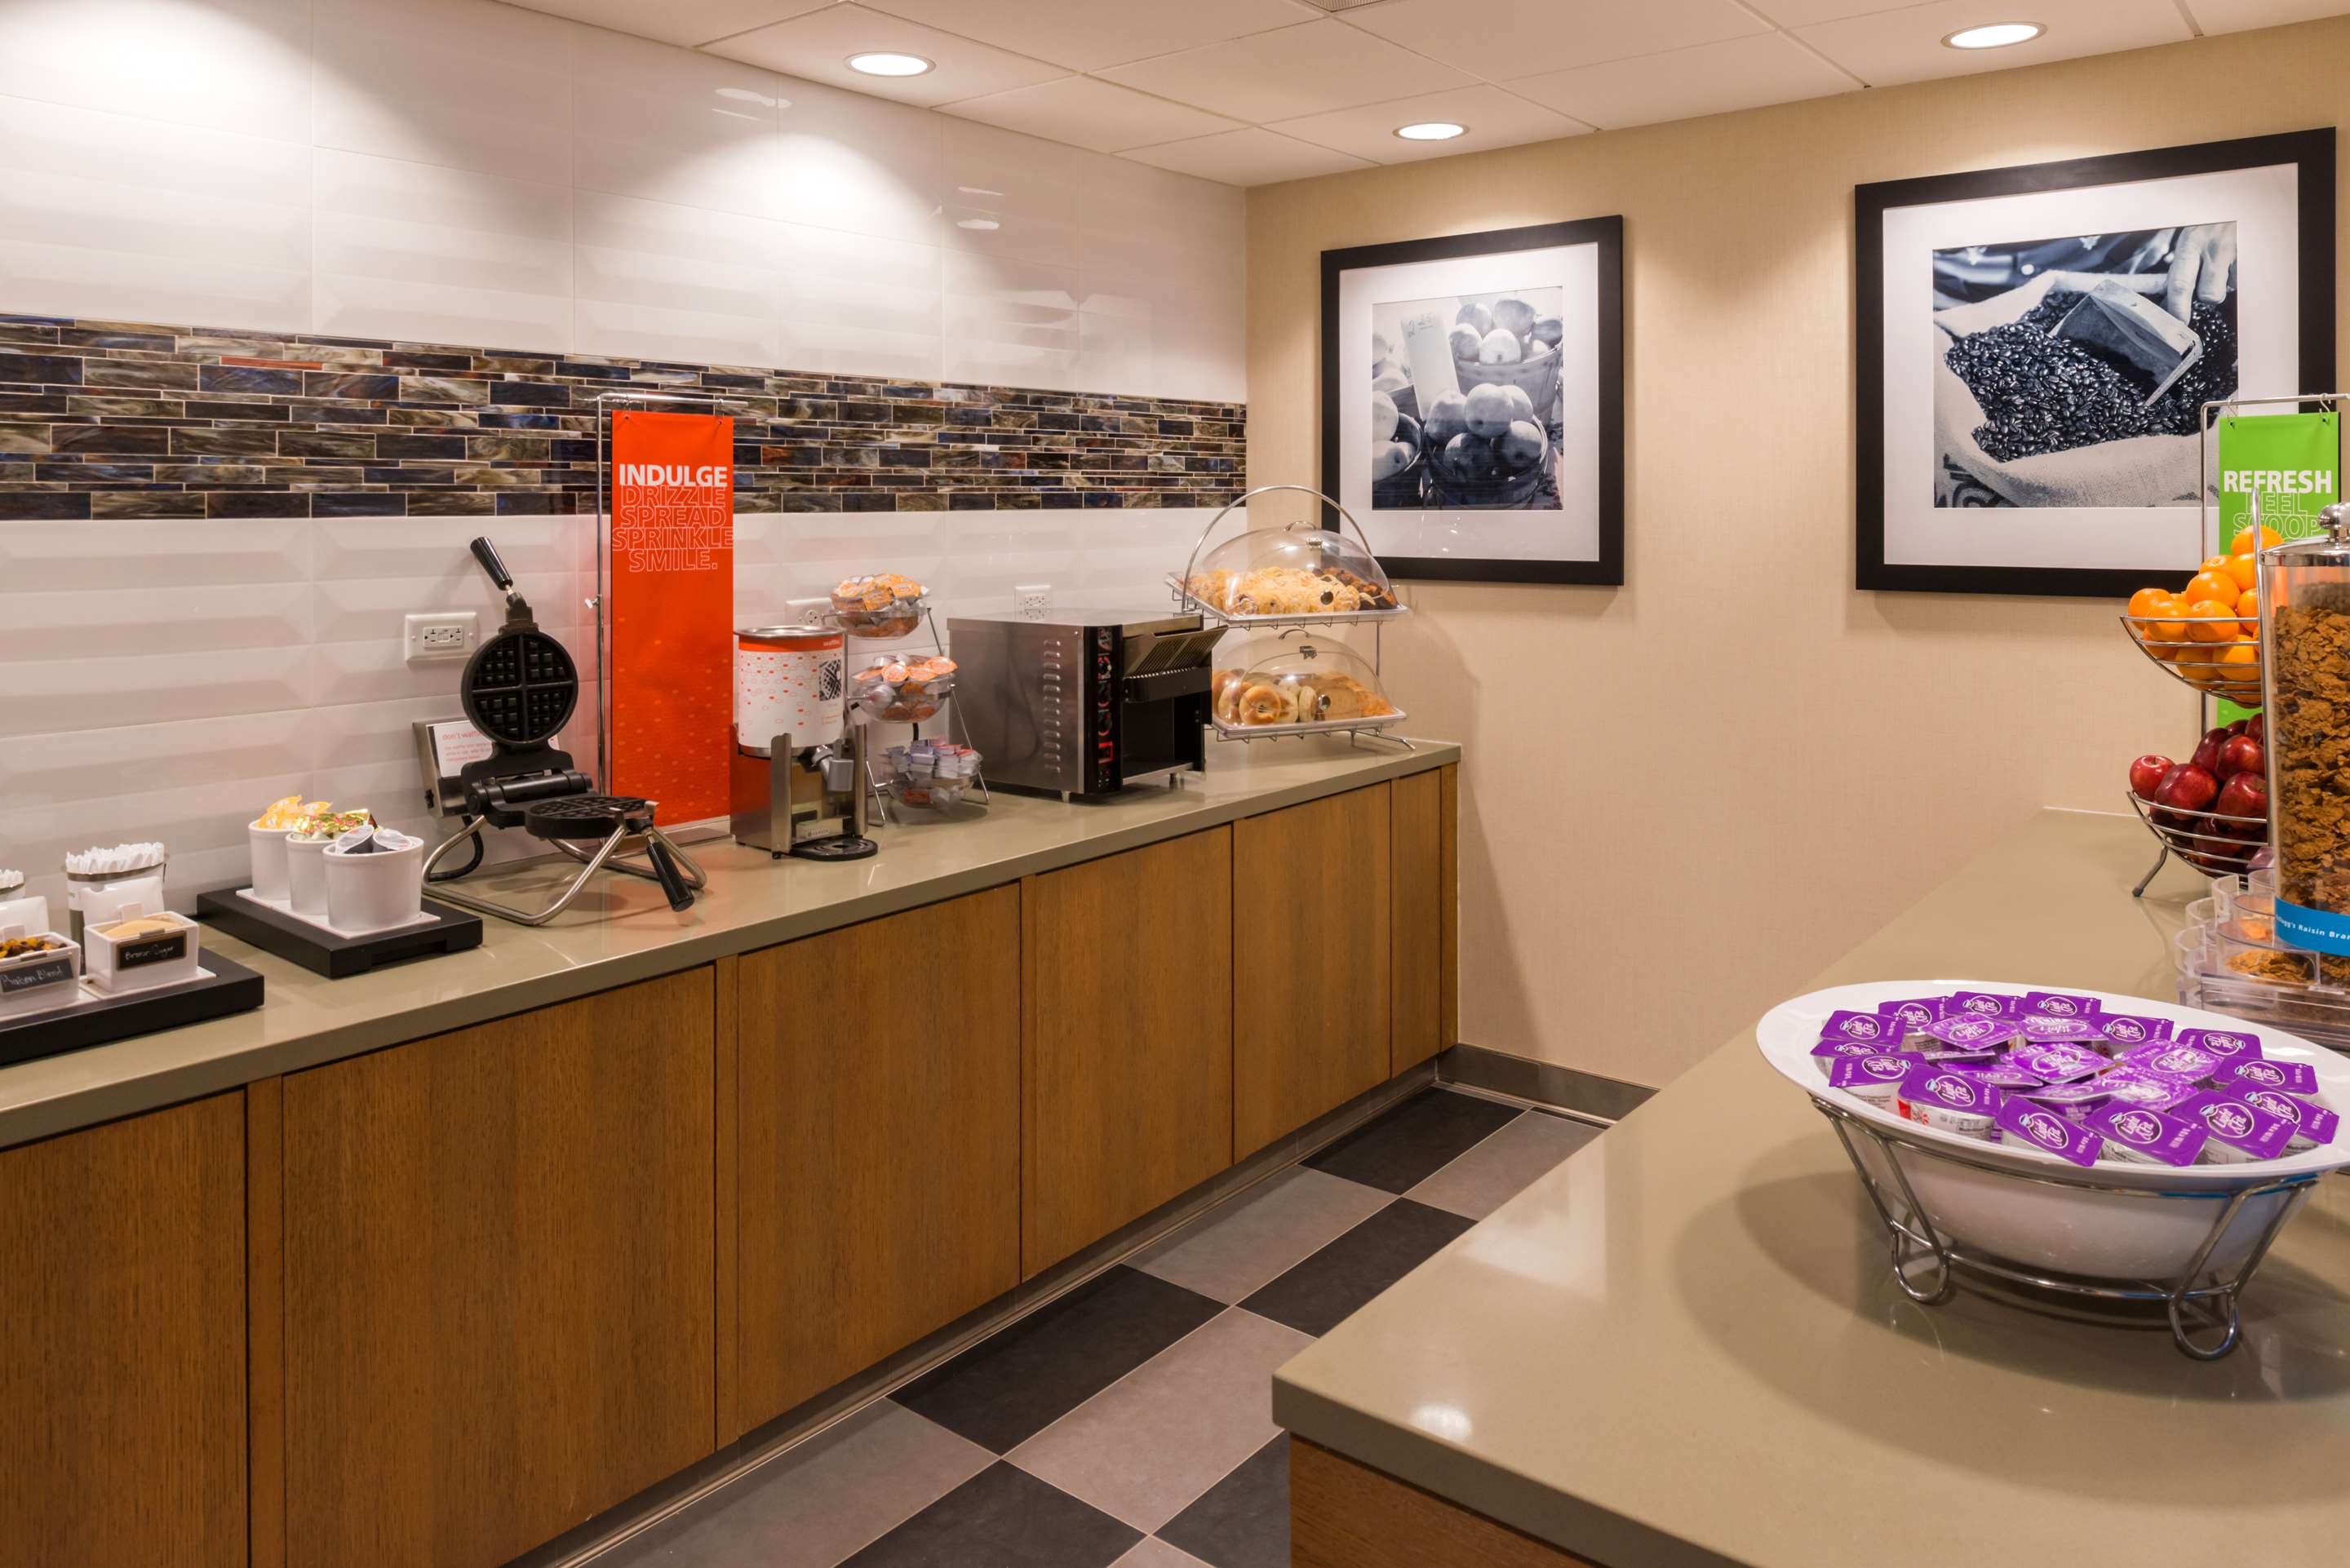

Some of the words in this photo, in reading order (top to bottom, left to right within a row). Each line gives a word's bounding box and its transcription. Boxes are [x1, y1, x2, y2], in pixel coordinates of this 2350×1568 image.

[619, 463, 728, 487] INDULGE
[2224, 470, 2332, 494] REFRESH
[621, 485, 725, 507] DRIZZLE
[620, 505, 726, 529] SPREAD
[612, 527, 734, 551] SPRINKLE
[629, 548, 718, 573] SMILE.
[2298, 924, 2326, 937] Raisin
